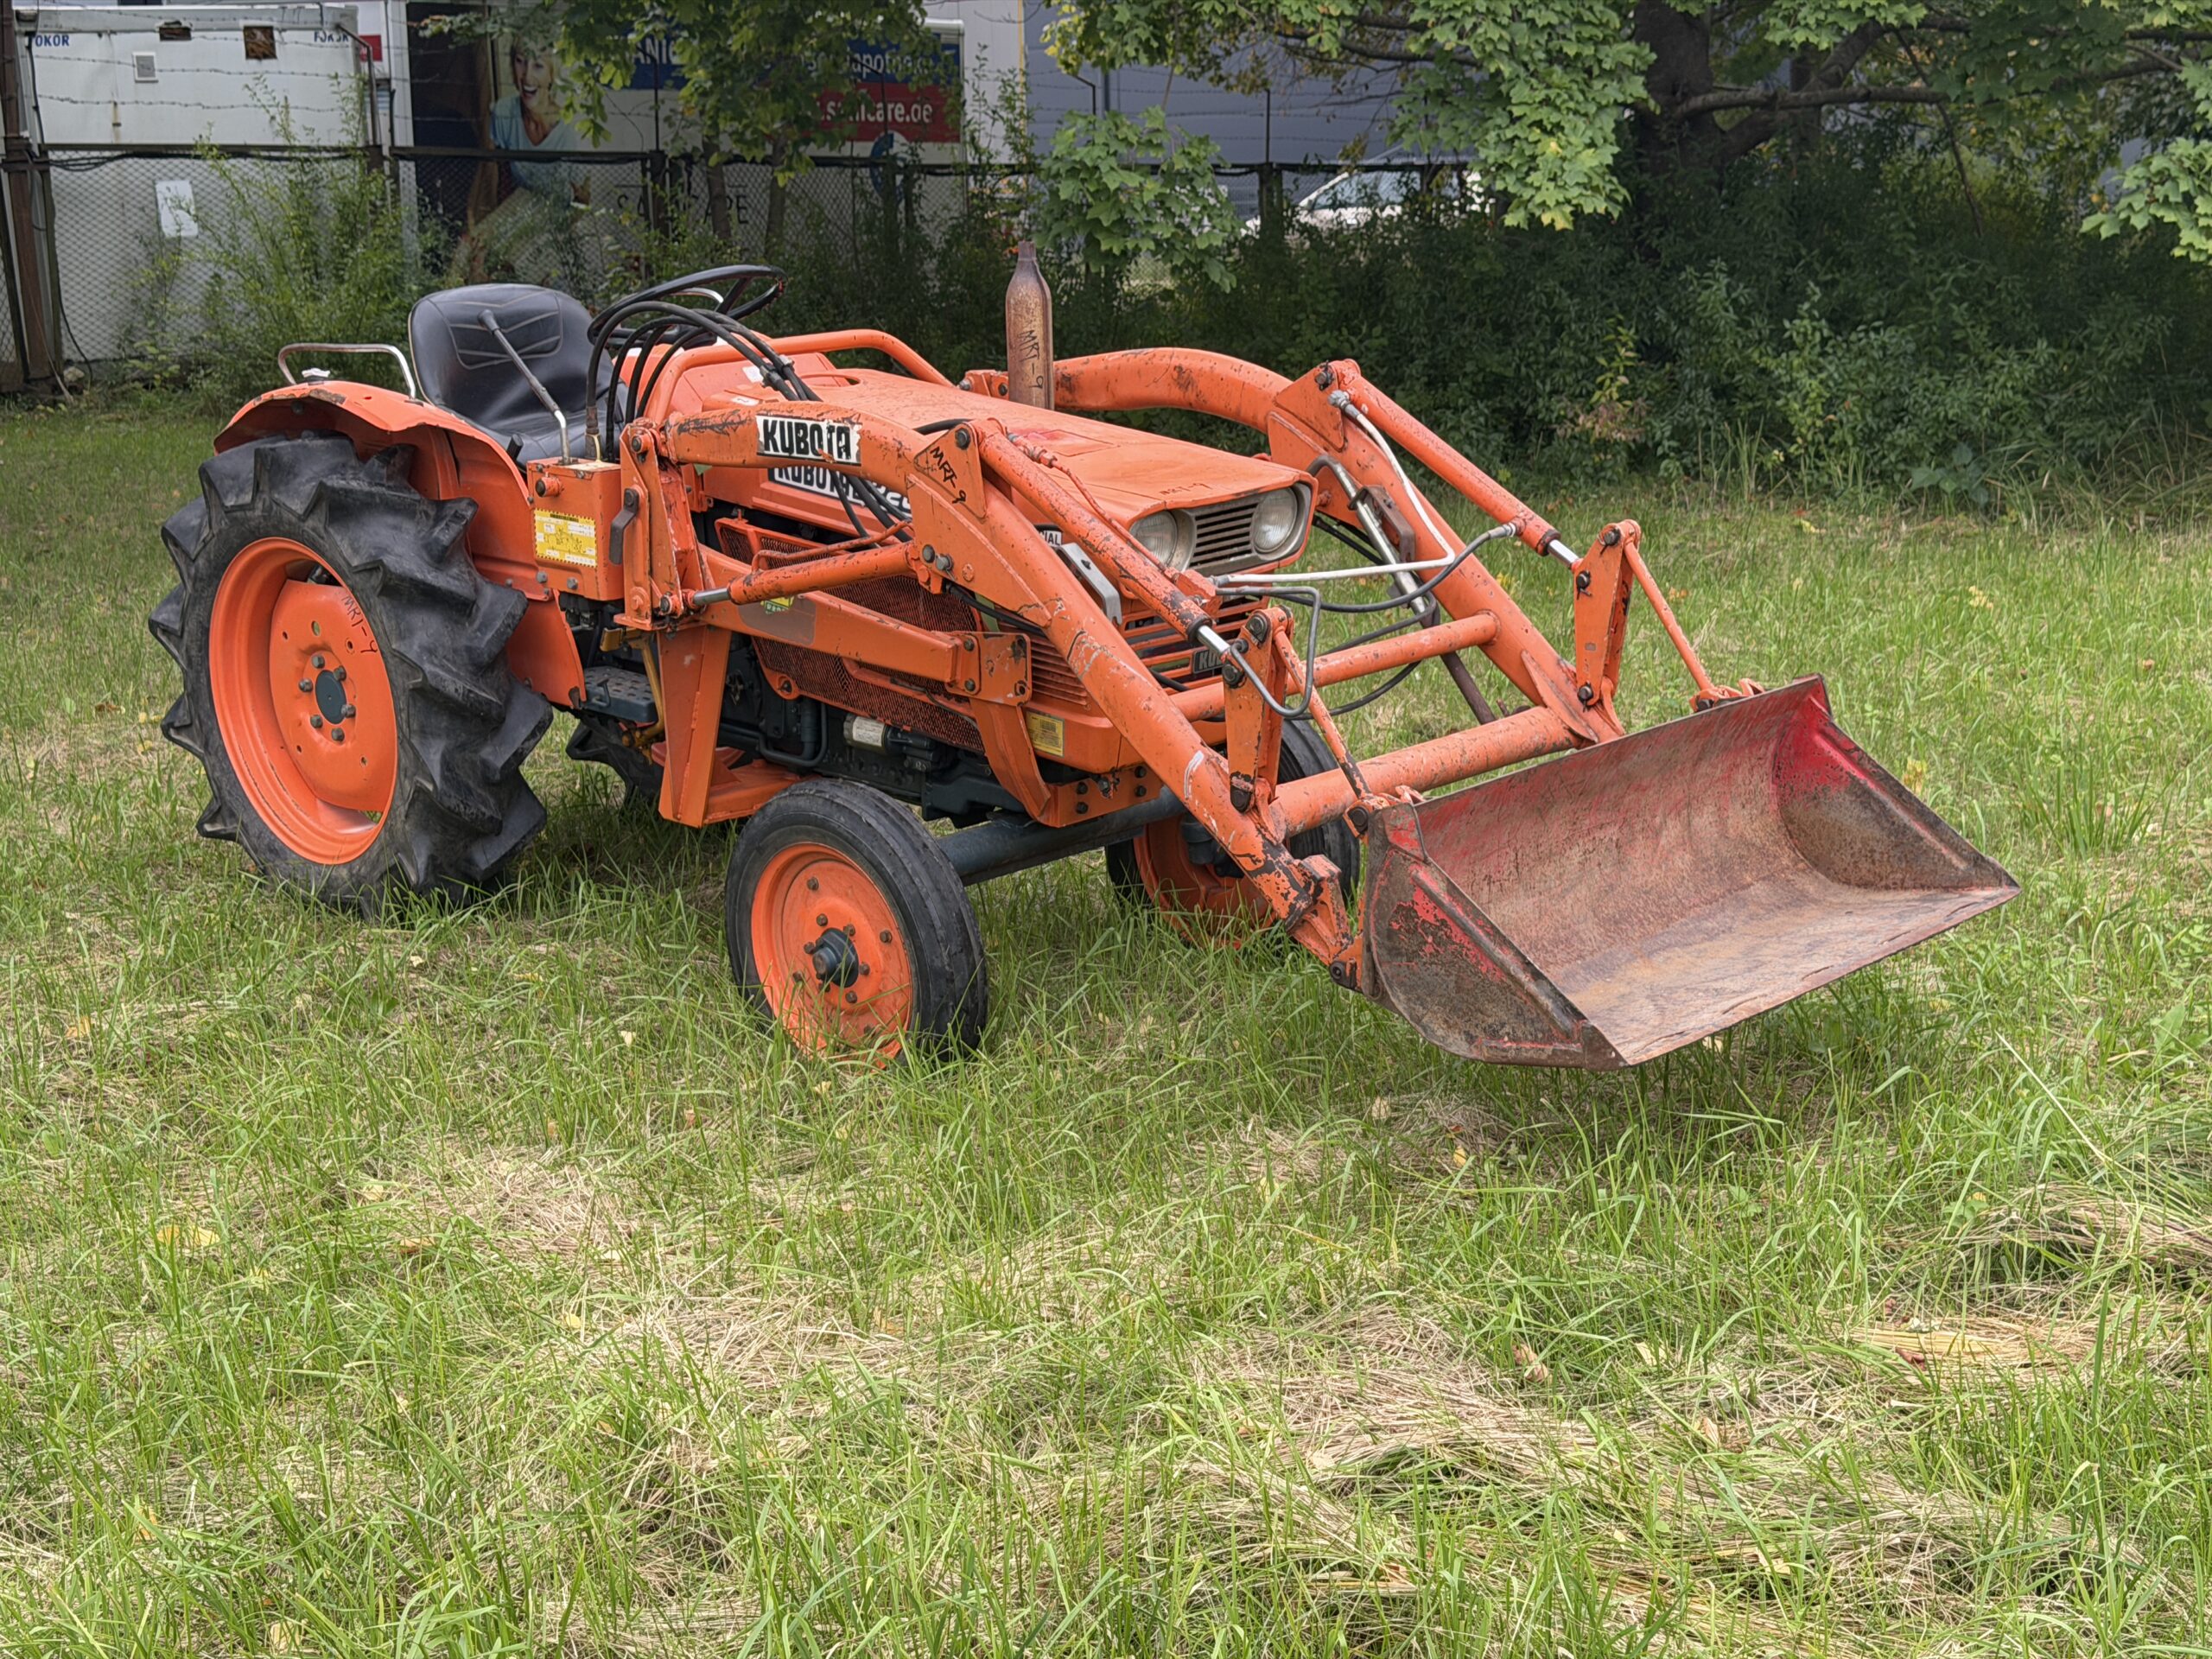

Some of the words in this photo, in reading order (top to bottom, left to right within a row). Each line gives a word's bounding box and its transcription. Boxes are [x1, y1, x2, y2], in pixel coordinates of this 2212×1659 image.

[35, 35, 70, 47] OKOR
[762, 419, 852, 461] KUBOTA
[1039, 531, 1061, 546] IAL
